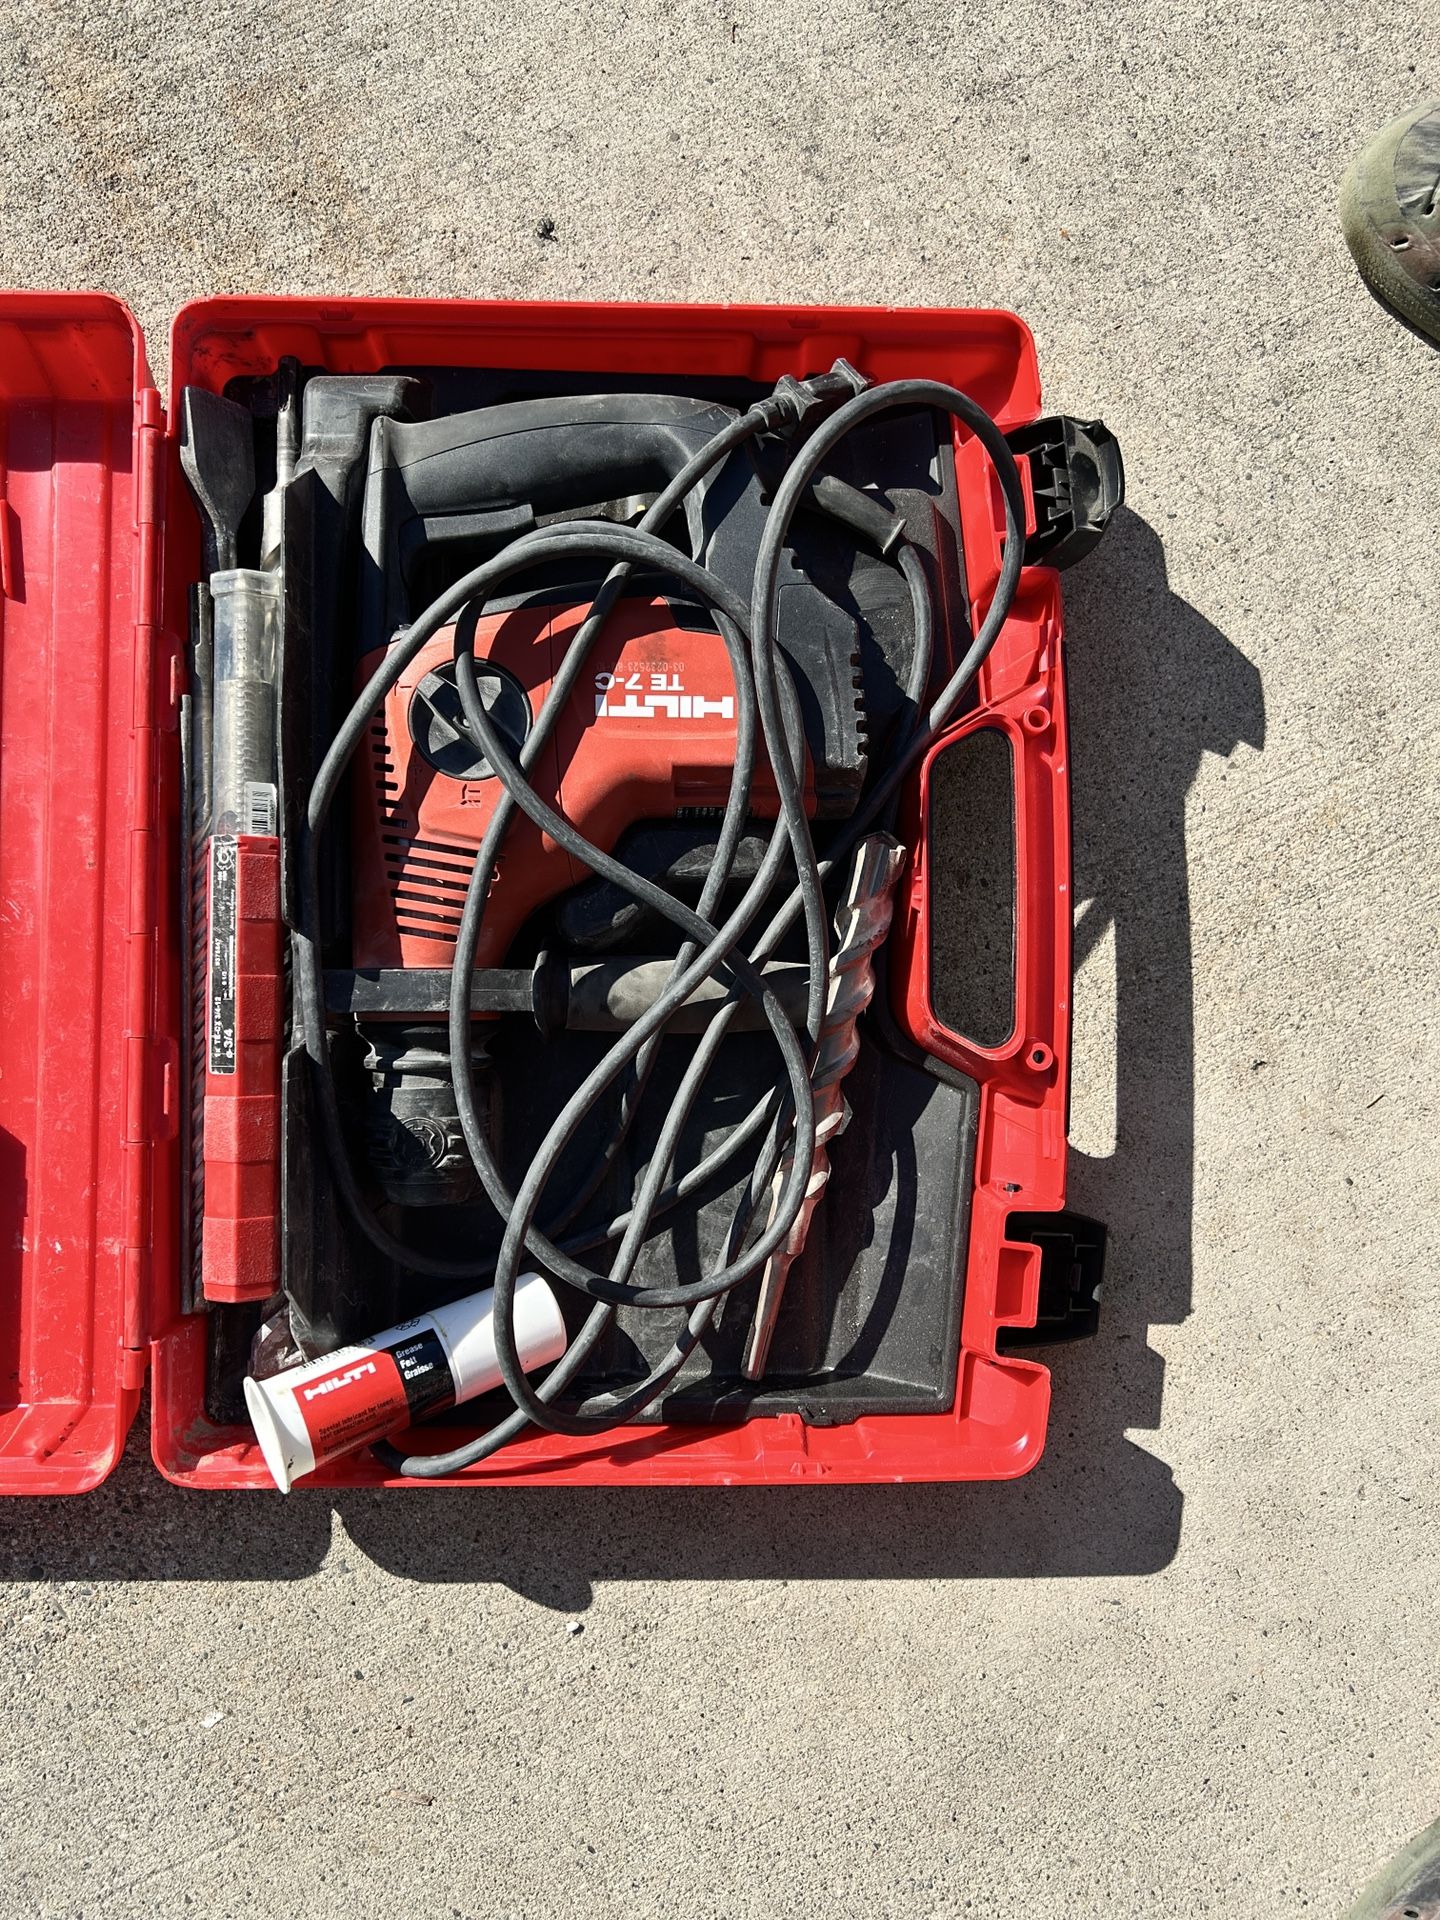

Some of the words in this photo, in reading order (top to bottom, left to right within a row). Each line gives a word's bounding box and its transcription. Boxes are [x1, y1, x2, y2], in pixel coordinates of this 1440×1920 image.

[595, 672, 643, 691] 7-C
[650, 674, 685, 691] TE
[595, 694, 734, 719] HILTI
[214, 996, 222, 1019] 3/4-12
[214, 1021, 222, 1045] TE-CX
[395, 1343, 424, 1359] Grease
[303, 1361, 377, 1402] HILTI
[404, 1362, 434, 1380] Graisse
